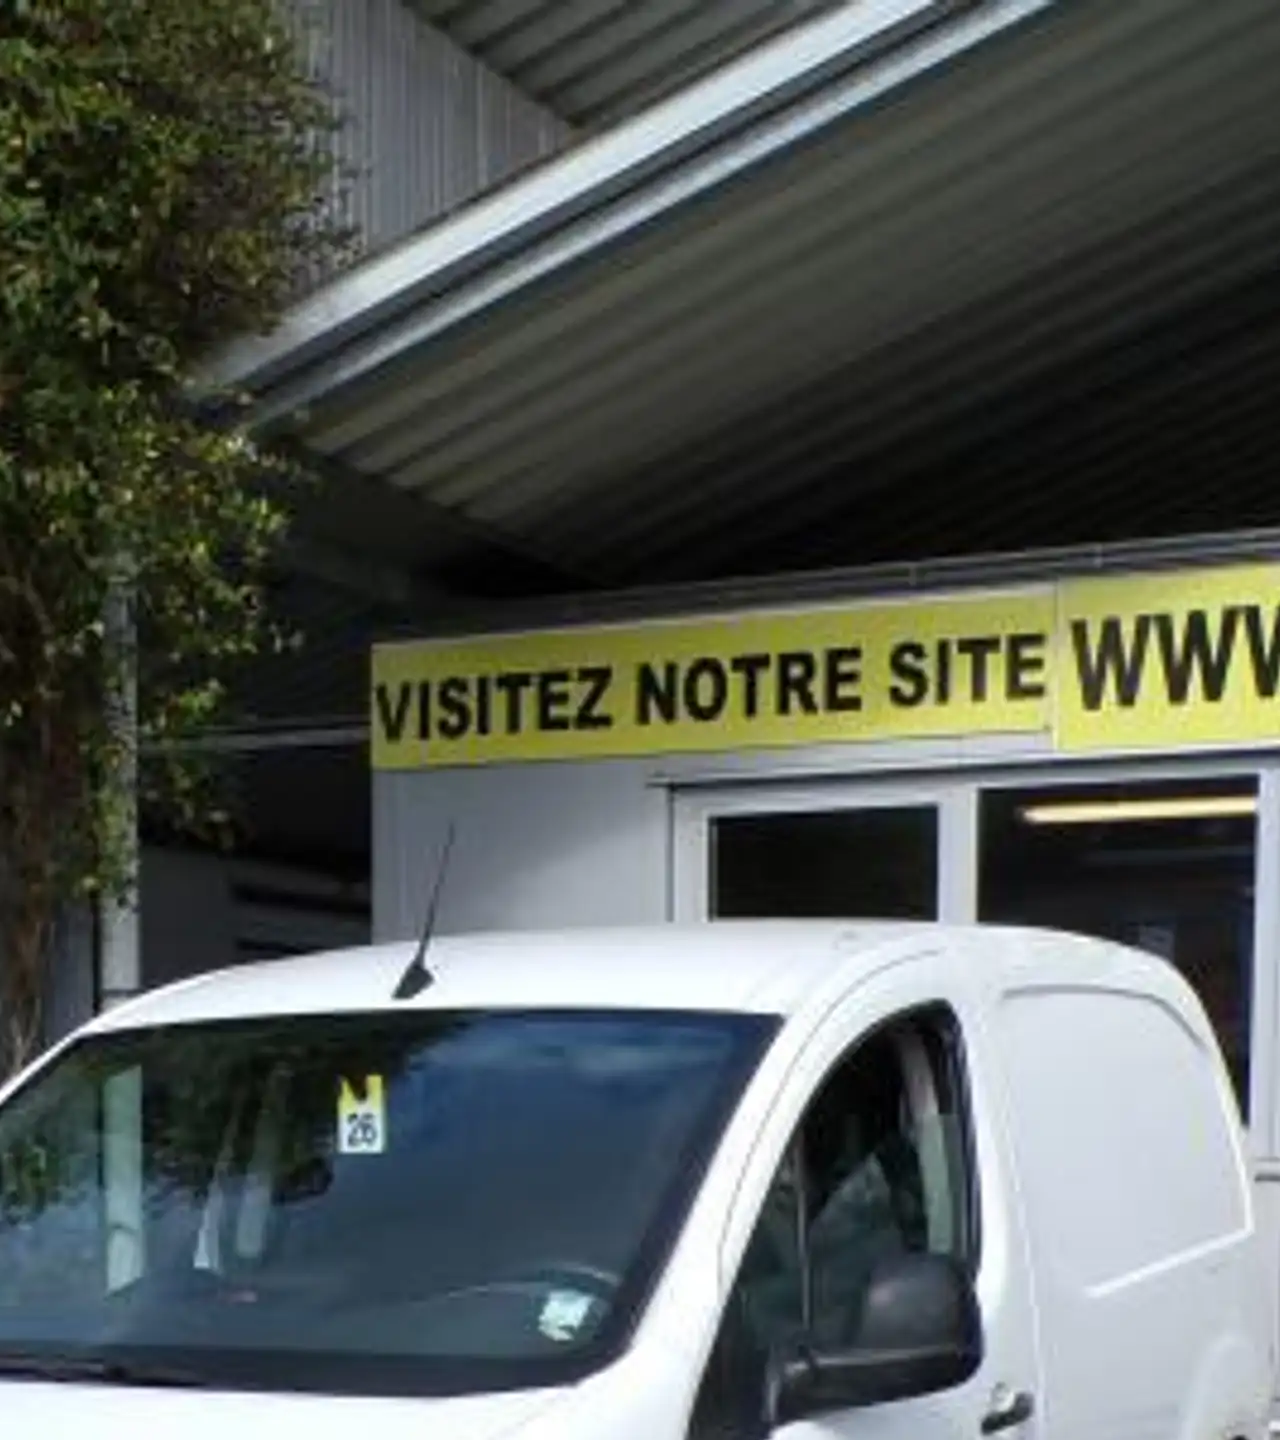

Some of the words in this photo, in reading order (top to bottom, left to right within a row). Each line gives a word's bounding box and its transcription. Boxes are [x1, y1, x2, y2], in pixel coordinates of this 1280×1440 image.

[376, 668, 613, 742] VISITEZ
[636, 647, 862, 725] NOTRE
[888, 632, 1045, 706] SITE
